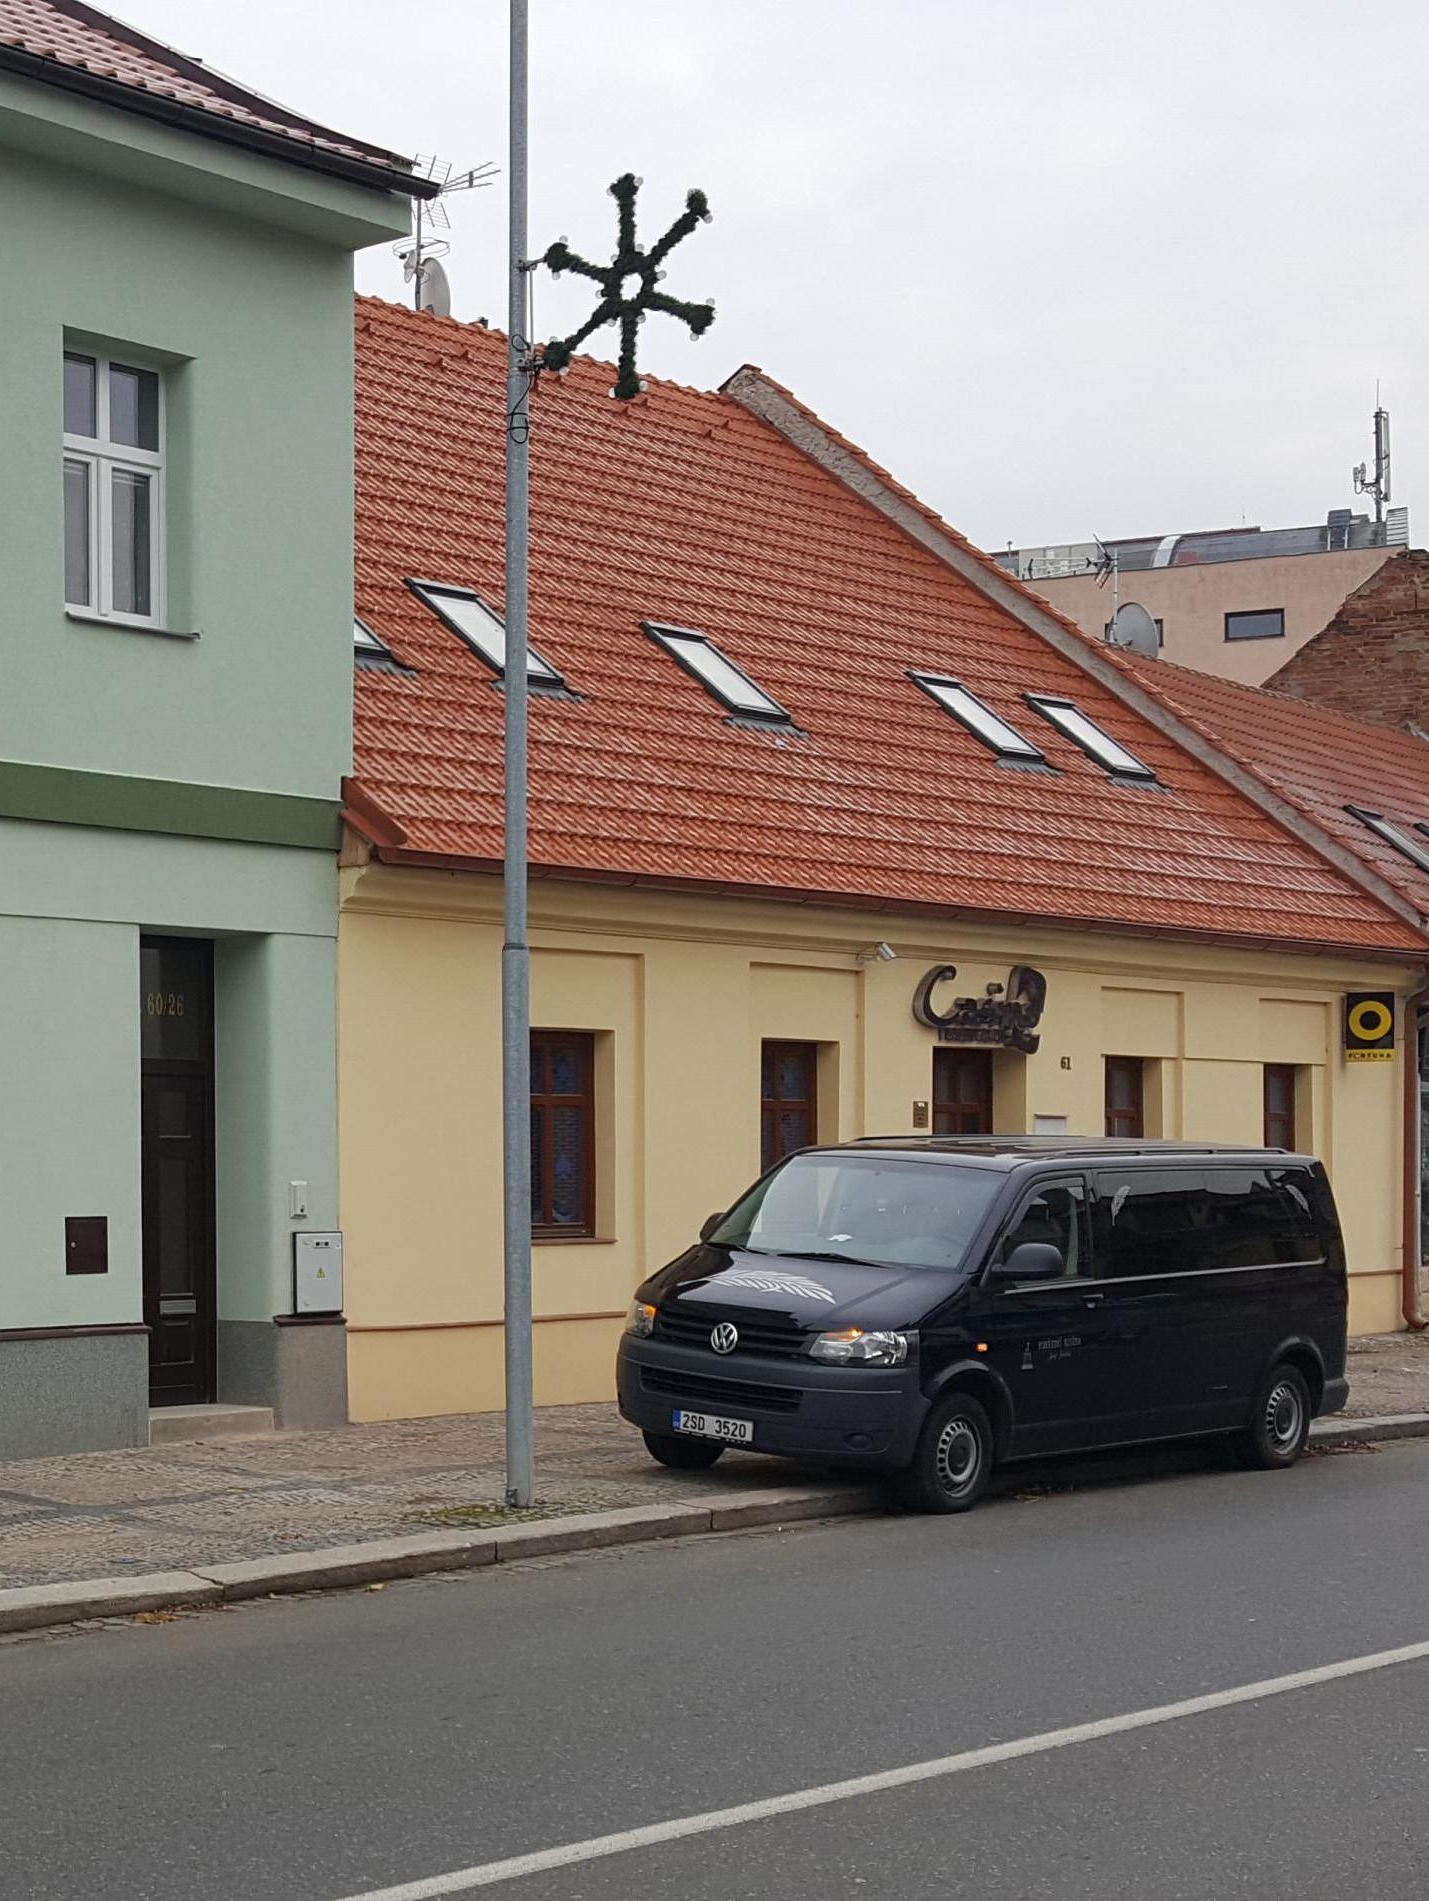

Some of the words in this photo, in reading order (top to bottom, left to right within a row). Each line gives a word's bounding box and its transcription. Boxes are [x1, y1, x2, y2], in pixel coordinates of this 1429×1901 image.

[1060, 1056, 1072, 1071] 61
[683, 1414, 706, 1431] 2SD
[715, 1420, 747, 1438] 3520
